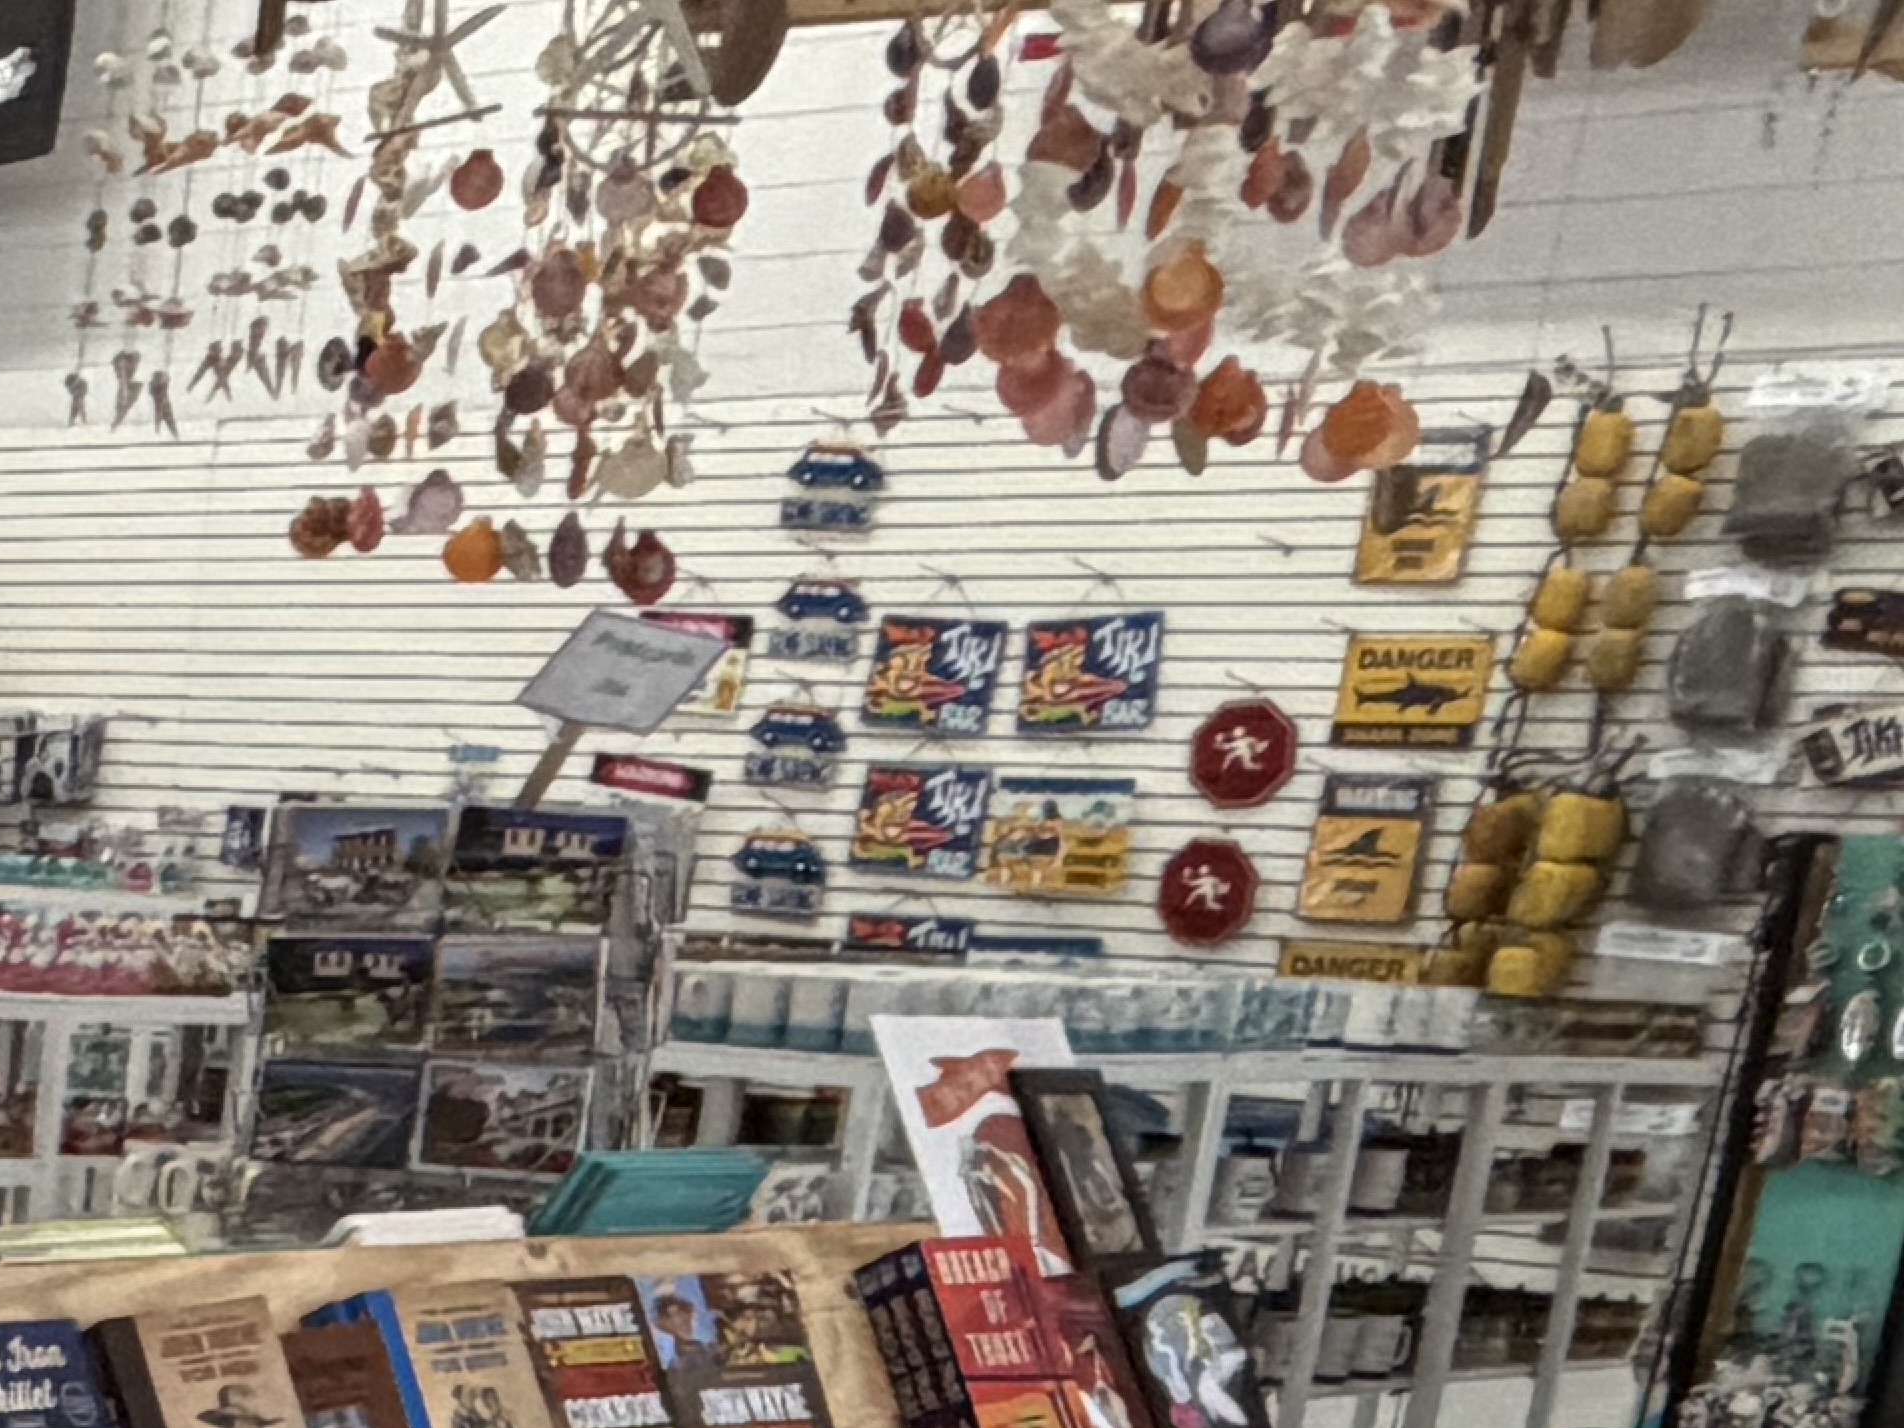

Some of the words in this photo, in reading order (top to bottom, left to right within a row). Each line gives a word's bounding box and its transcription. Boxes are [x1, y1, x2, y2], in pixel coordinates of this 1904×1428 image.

[1093, 618, 1159, 680] TIKI
[1357, 647, 1475, 671] DANGER
[1290, 956, 1407, 982] DANGER
[933, 1246, 1012, 1286] BREACH
[980, 1289, 1008, 1325] OF
[6, 1336, 67, 1371] Iron
